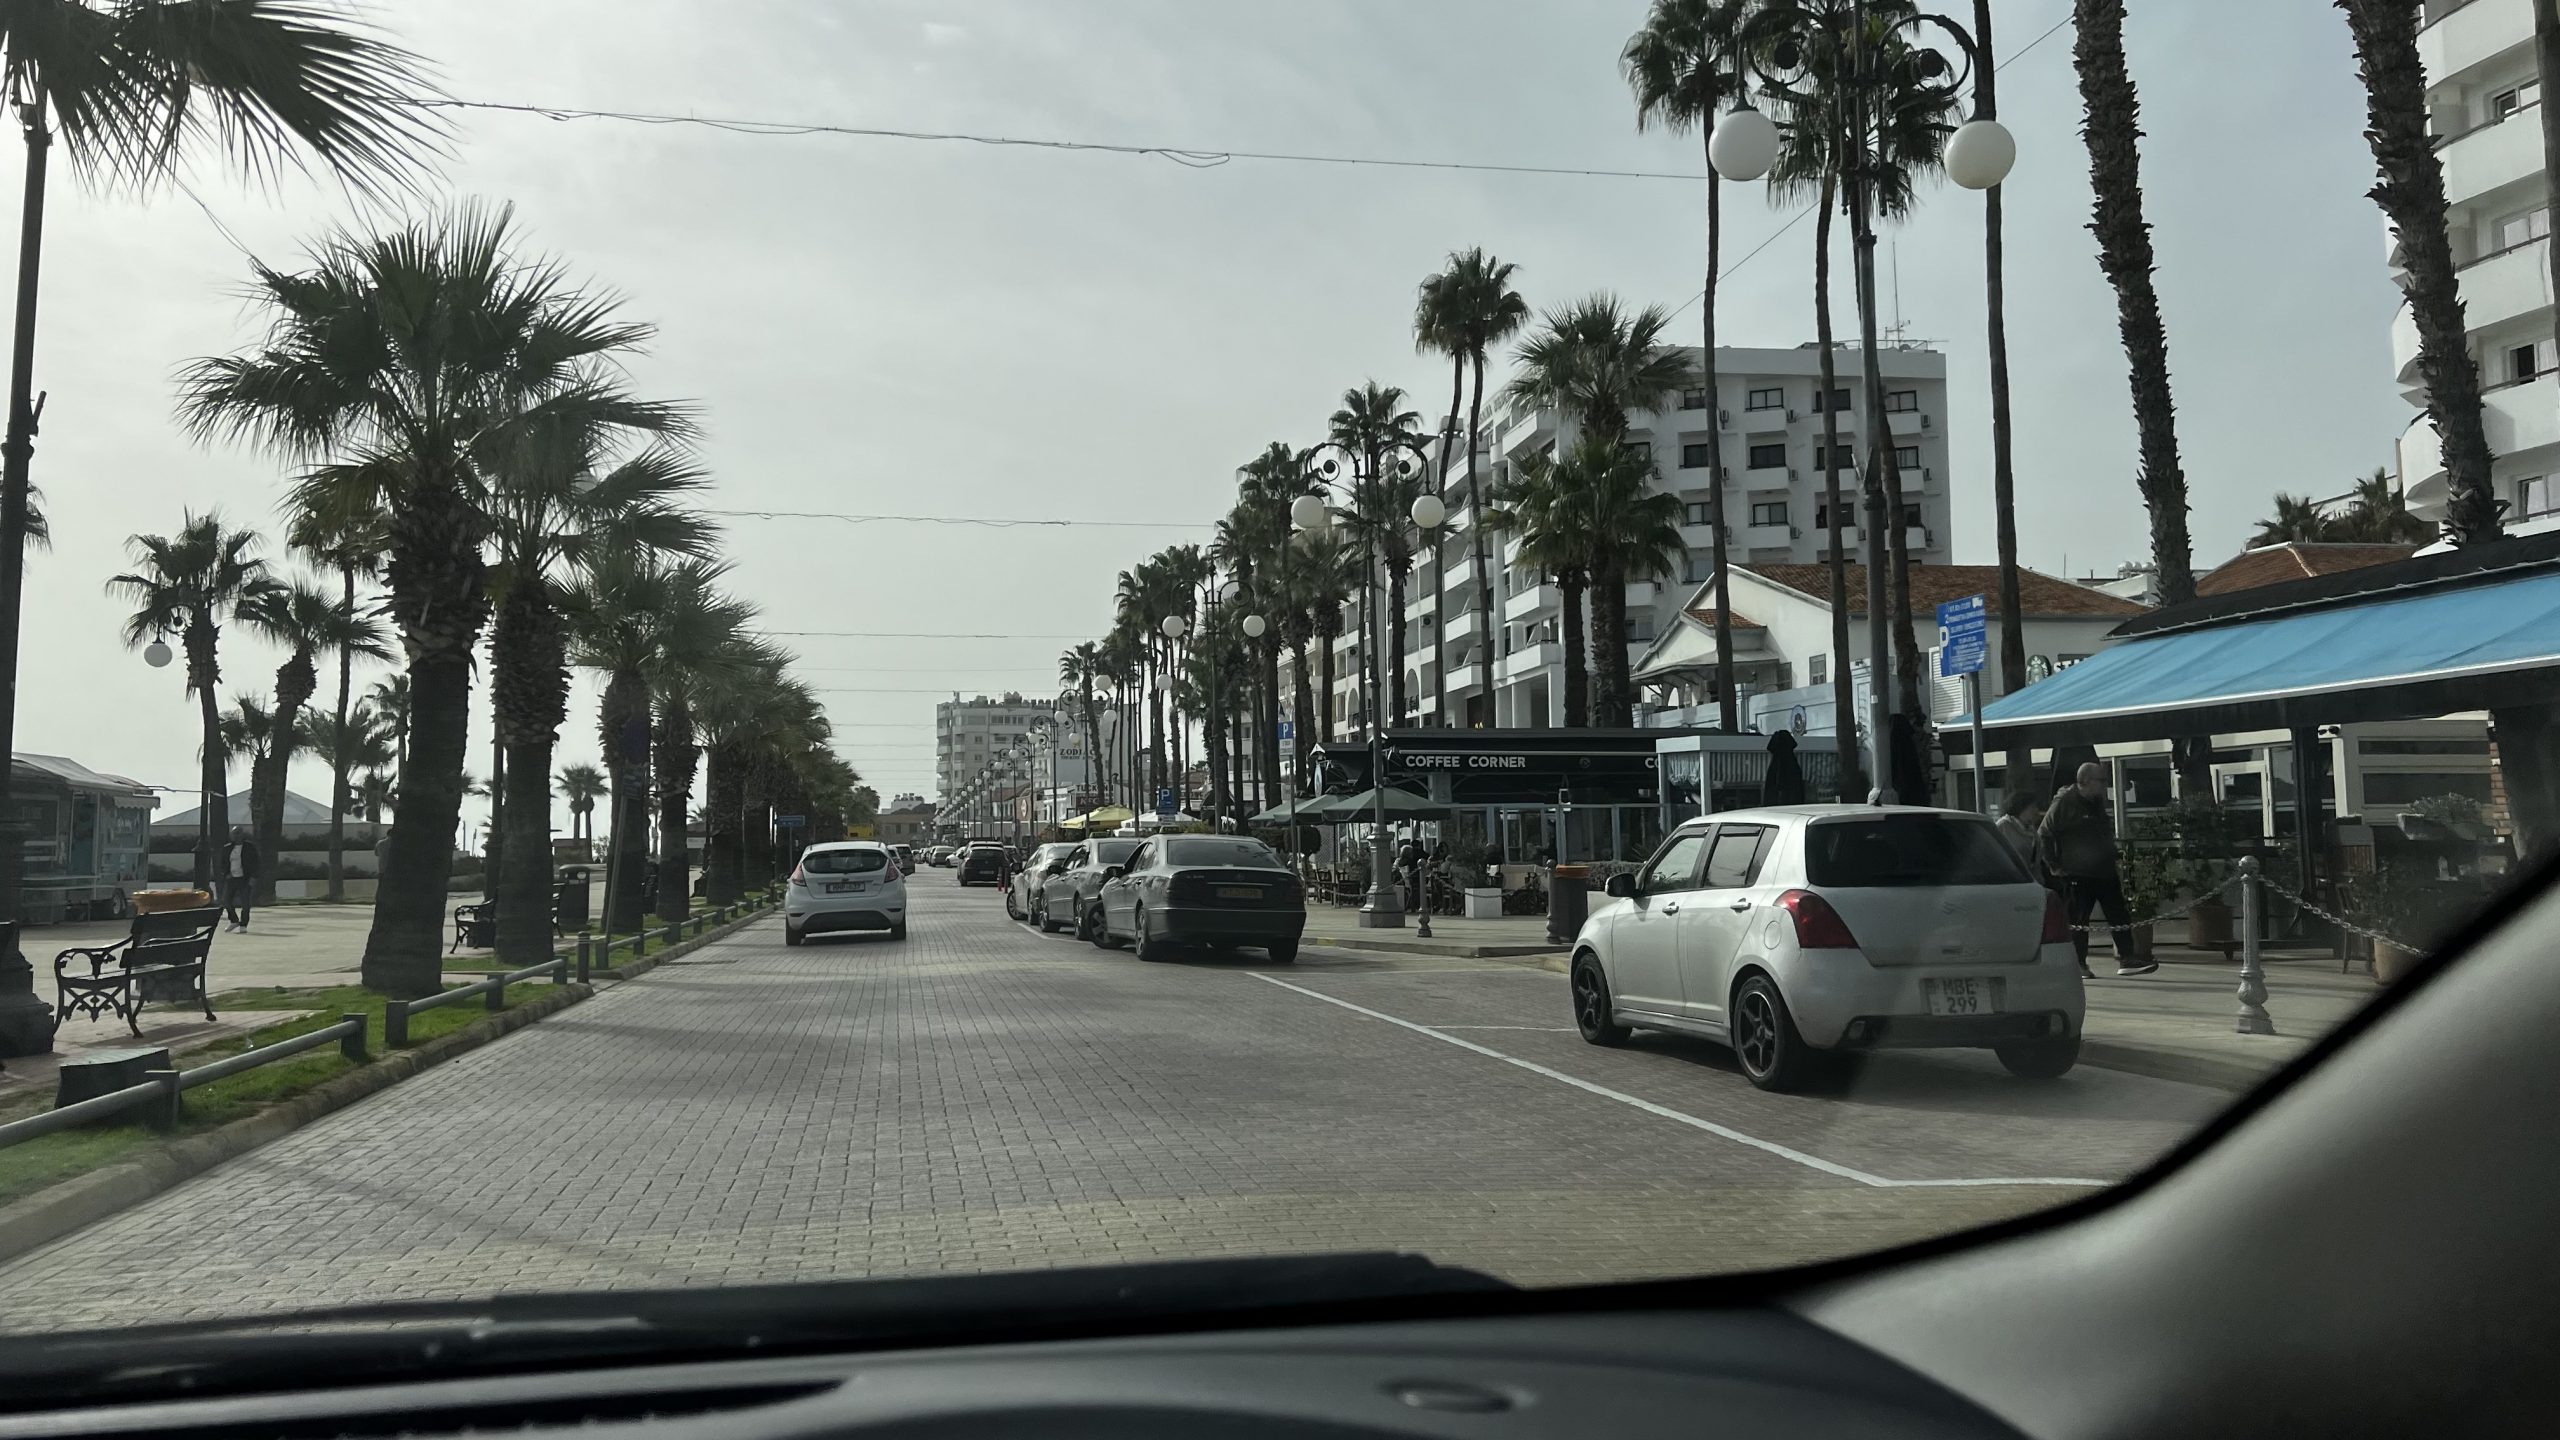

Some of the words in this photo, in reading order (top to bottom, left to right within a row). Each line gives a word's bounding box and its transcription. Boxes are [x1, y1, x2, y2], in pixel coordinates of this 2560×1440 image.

[1939, 625, 1949, 659] P
[1283, 722, 1289, 739] P
[1060, 748, 1095, 756] ZODIC
[1405, 755, 1461, 768] COFFEE
[1468, 756, 1526, 768] CORNER
[1161, 789, 1170, 801] P
[1943, 978, 1977, 995] MBE
[1946, 996, 1977, 1014] 299
